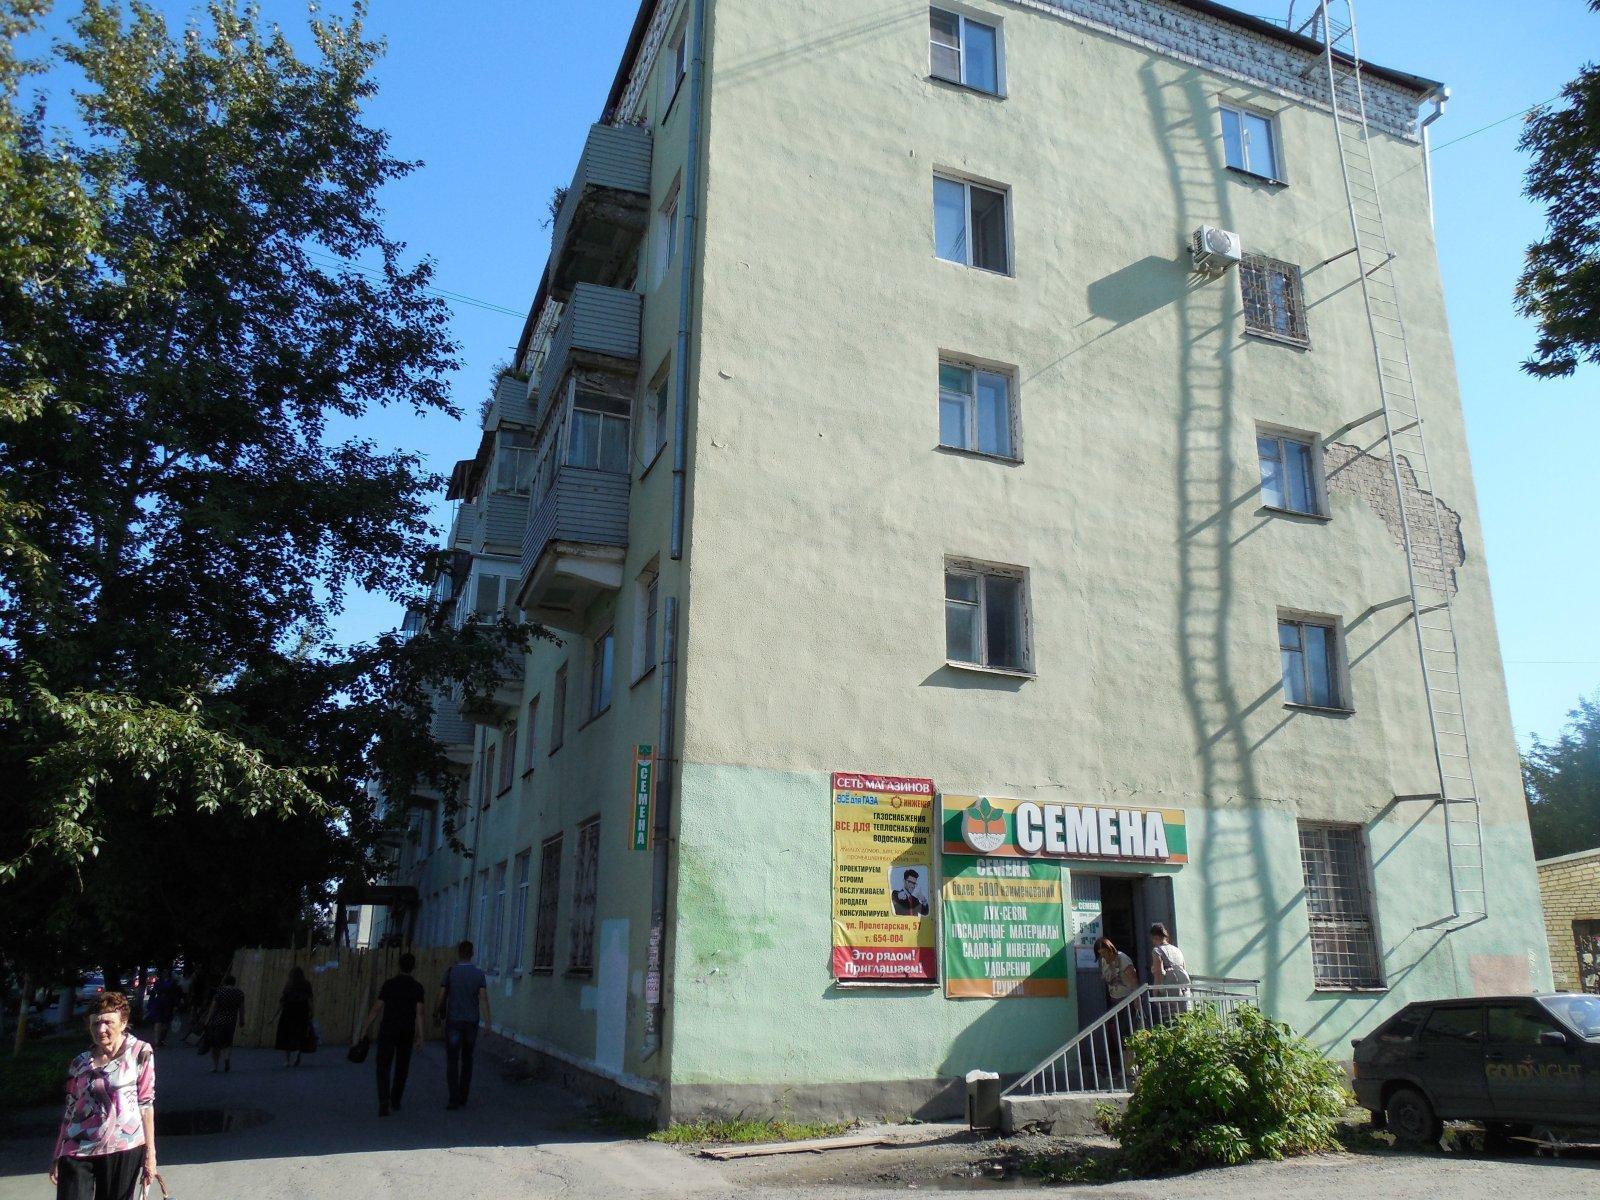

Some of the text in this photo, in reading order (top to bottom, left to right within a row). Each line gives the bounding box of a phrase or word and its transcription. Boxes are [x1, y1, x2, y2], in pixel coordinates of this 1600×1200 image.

[837, 778, 930, 792] СЕТЬ МАГАЗИНОВ
[637, 767, 648, 845] СЕМЕНА
[862, 796, 878, 805] ГАЗА
[873, 813, 926, 822] ГАЗОСНАБЖЕНИЯ
[836, 821, 870, 833] ВСЕ ДЛЯ
[873, 824, 929, 834] ТЕПЛОСНАБЖЕНИЯ
[1014, 801, 1170, 858] СЕМЕНА
[873, 835, 927, 845] ВОДОСНАБЖЕНИЯ
[839, 865, 881, 873] ПРОЕКТИРУЕМ
[976, 859, 1030, 877] СЕМЕНА
[839, 887, 885, 895] ОБСЛУЖИВАЕМ
[953, 881, 1055, 898] более 5000 наименований
[839, 898, 868, 906] ПРОДАЕМ
[1078, 902, 1100, 910] СЕМЕНА
[839, 909, 889, 917] КОНСУЛЬТИРУЕМ
[984, 906, 1027, 921] ЛУК-СЕВОК
[846, 922, 856, 931] ул.
[858, 921, 910, 931] Пролетарская,
[952, 924, 1005, 940] ПОСАДОЧНЫЕ
[1010, 925, 1059, 939] МАТЕРИАЛЫ
[873, 934, 904, 943] 654-004
[852, 950, 915, 961] Это рядом!
[962, 941, 1051, 959] САДОВЫЙ ИНВЕНТАРЬ
[845, 962, 923, 974] Приглашаем!
[984, 961, 1030, 979] УДОБРЕНИЯ
